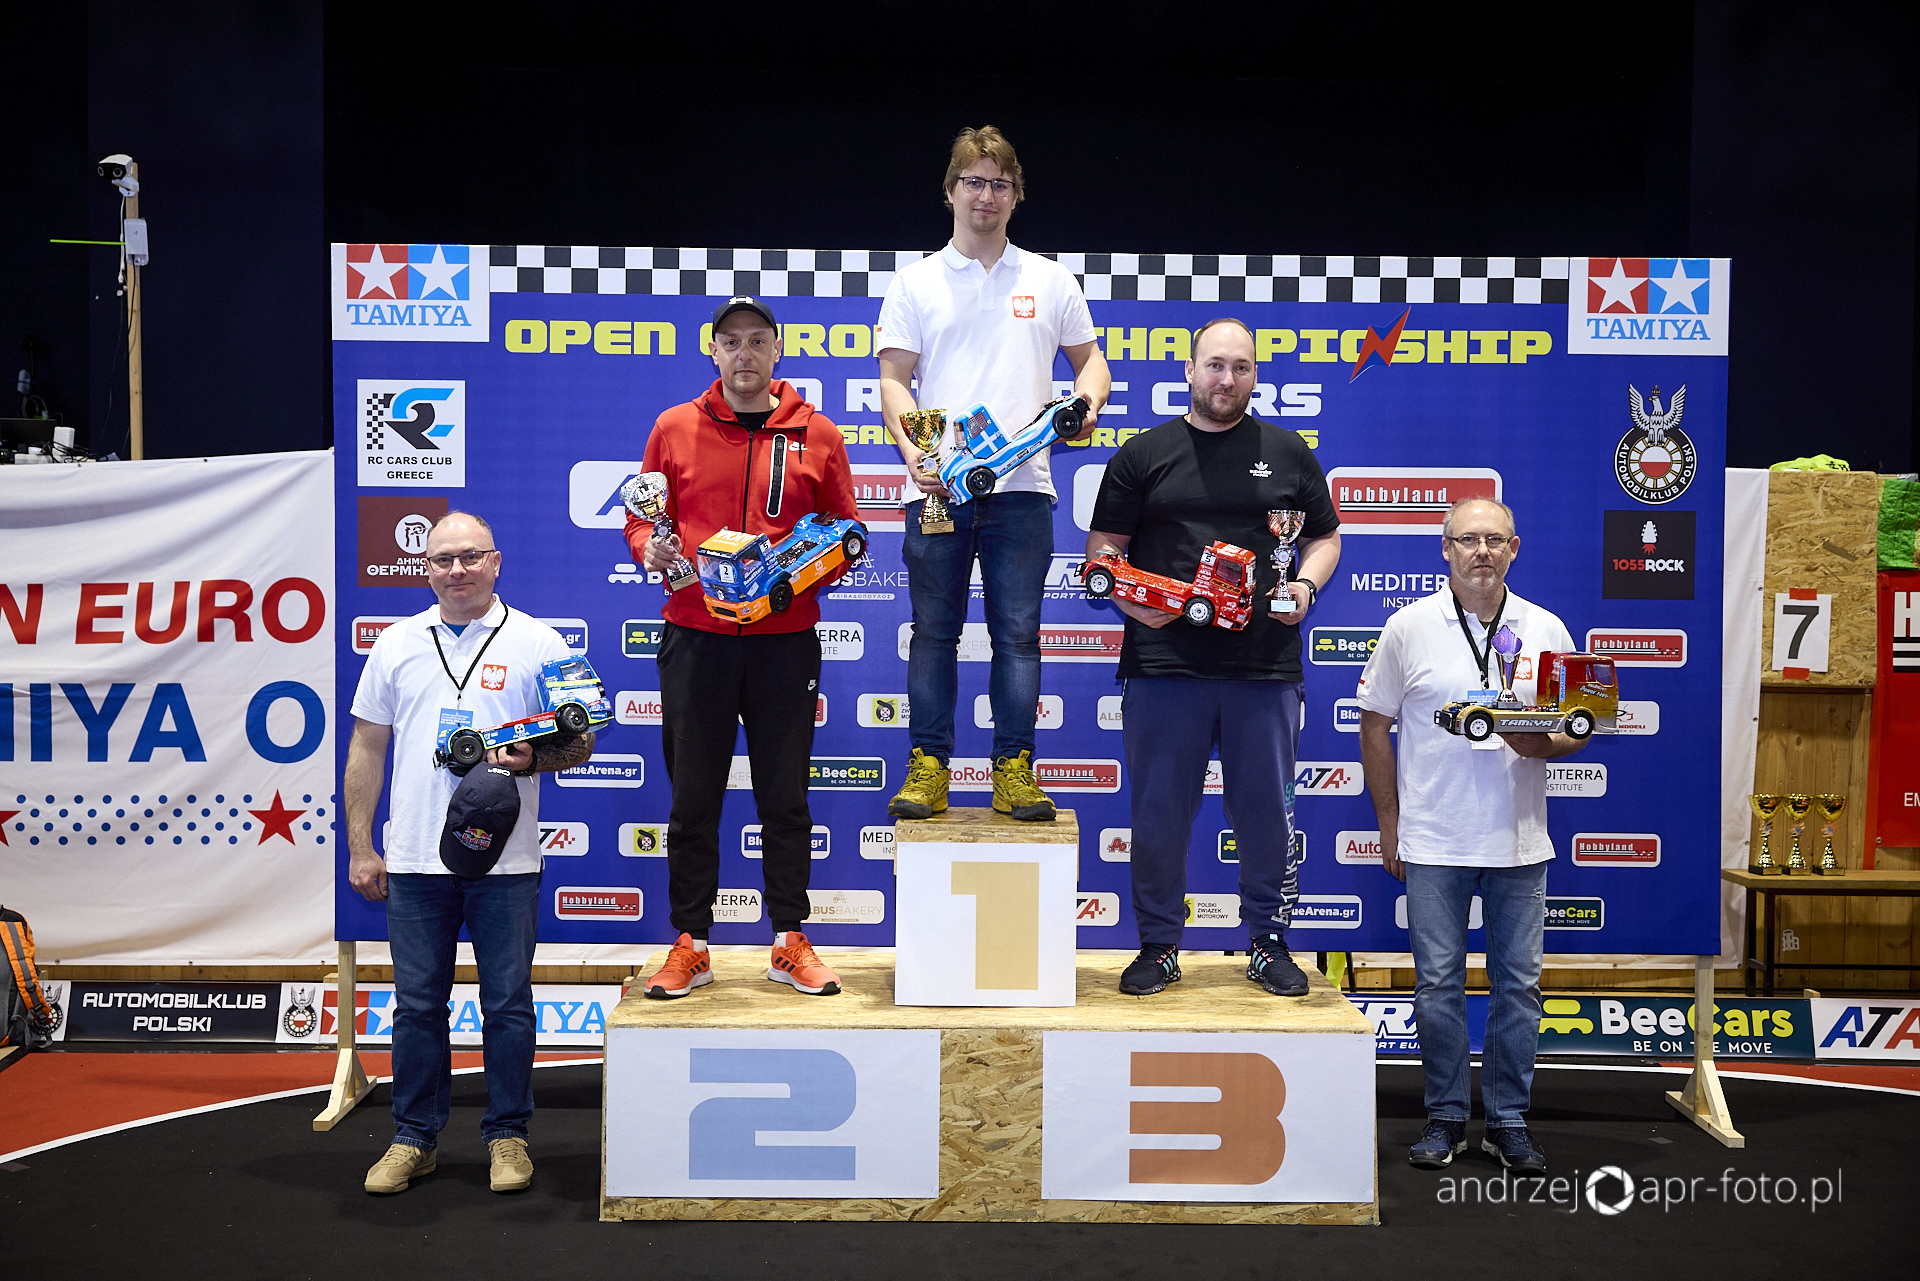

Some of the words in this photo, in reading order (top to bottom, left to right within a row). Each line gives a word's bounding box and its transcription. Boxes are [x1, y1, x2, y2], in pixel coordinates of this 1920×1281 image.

[347, 304, 472, 326] TAMIYA
[1586, 318, 1710, 340] TAMIYA
[505, 320, 676, 355] OPEN
[1152, 382, 1322, 416] CRS
[368, 456, 383, 464] RC
[387, 456, 418, 465] CARS
[422, 457, 452, 465] CLUB
[1680, 444, 1694, 484] POLSKI
[387, 471, 434, 480] GREECE
[1619, 443, 1680, 500] AUTOMOBILKLUB
[1340, 486, 1448, 504] Hobbyland
[1613, 558, 1684, 572] 1055ROCK
[75, 577, 326, 644] EURO
[816, 630, 862, 642] ERRA
[1782, 604, 1820, 659] 7
[1040, 634, 1102, 646] Hobbyland
[1594, 640, 1656, 650] Hobbyland
[246, 680, 326, 764] O
[1340, 710, 1361, 719] Blu
[822, 766, 878, 779] BeeCars
[1040, 768, 1094, 778] Hobbyland
[1580, 842, 1634, 852] Hobbyland
[562, 896, 616, 905] Hobbyland
[951, 861, 1039, 990] 1
[82, 993, 266, 1009] AUTOMOBILKLUB
[132, 1016, 212, 1032] POLSKI
[1633, 1040, 1651, 1052] BE
[1660, 1041, 1682, 1053] ON
[1728, 1042, 1773, 1054] MOVE
[689, 1048, 857, 1181] 2
[1129, 1052, 1287, 1185] 3
